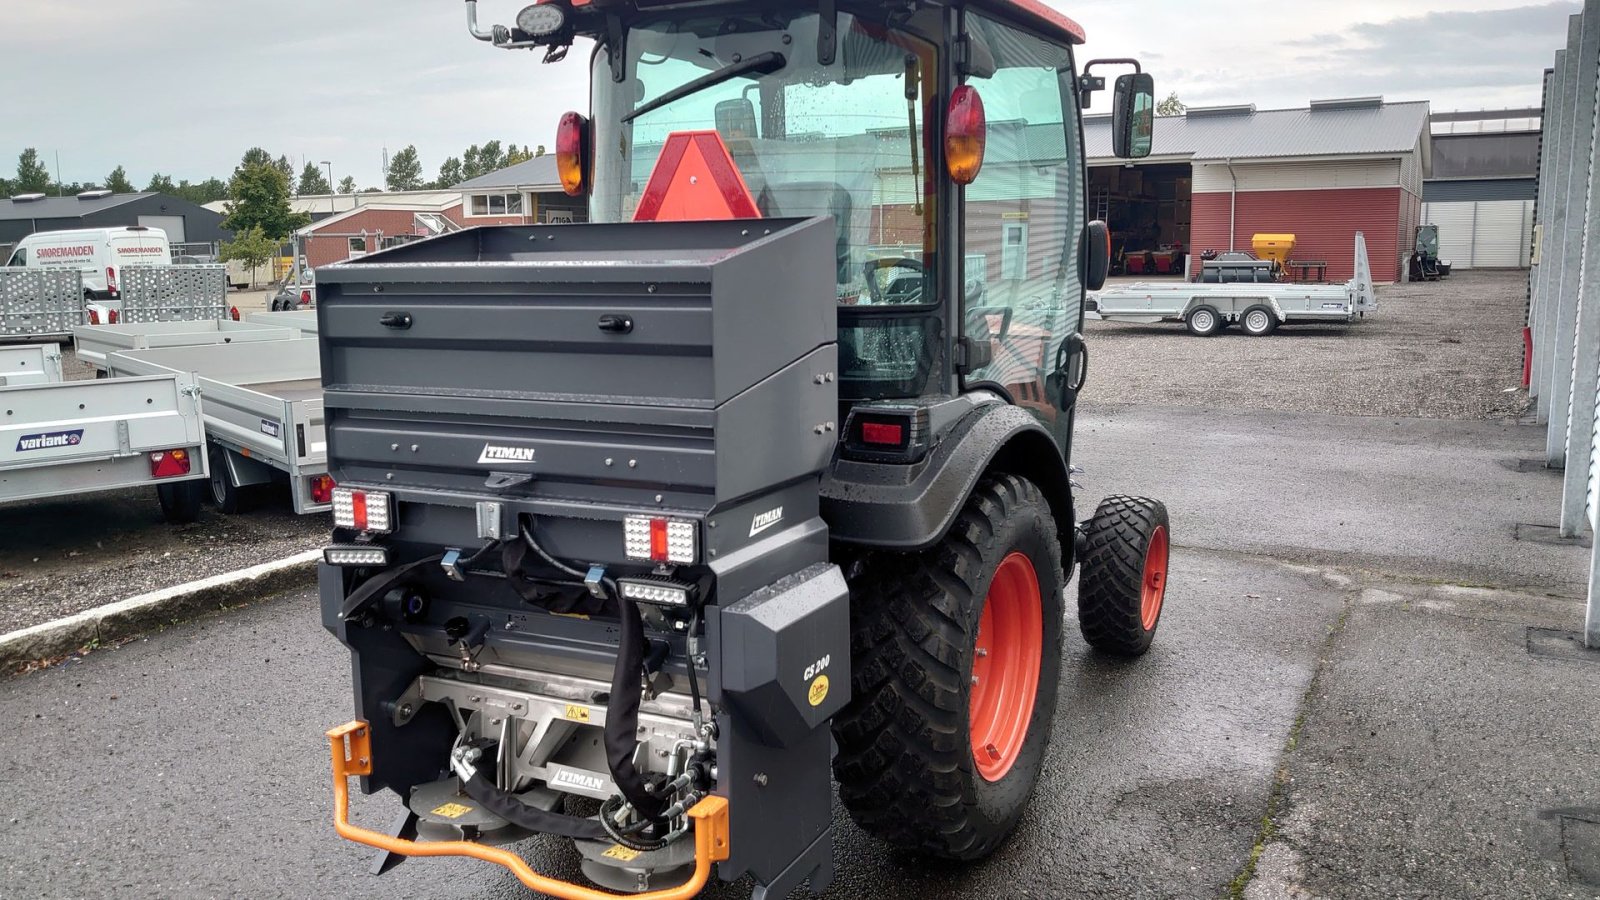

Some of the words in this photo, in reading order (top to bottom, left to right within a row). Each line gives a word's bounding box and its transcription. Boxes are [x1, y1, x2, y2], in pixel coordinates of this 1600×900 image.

[36, 246, 94, 258] SMØREMANDEN
[21, 434, 69, 449] variant
[804, 664, 815, 681] CS
[815, 654, 830, 674] 200
